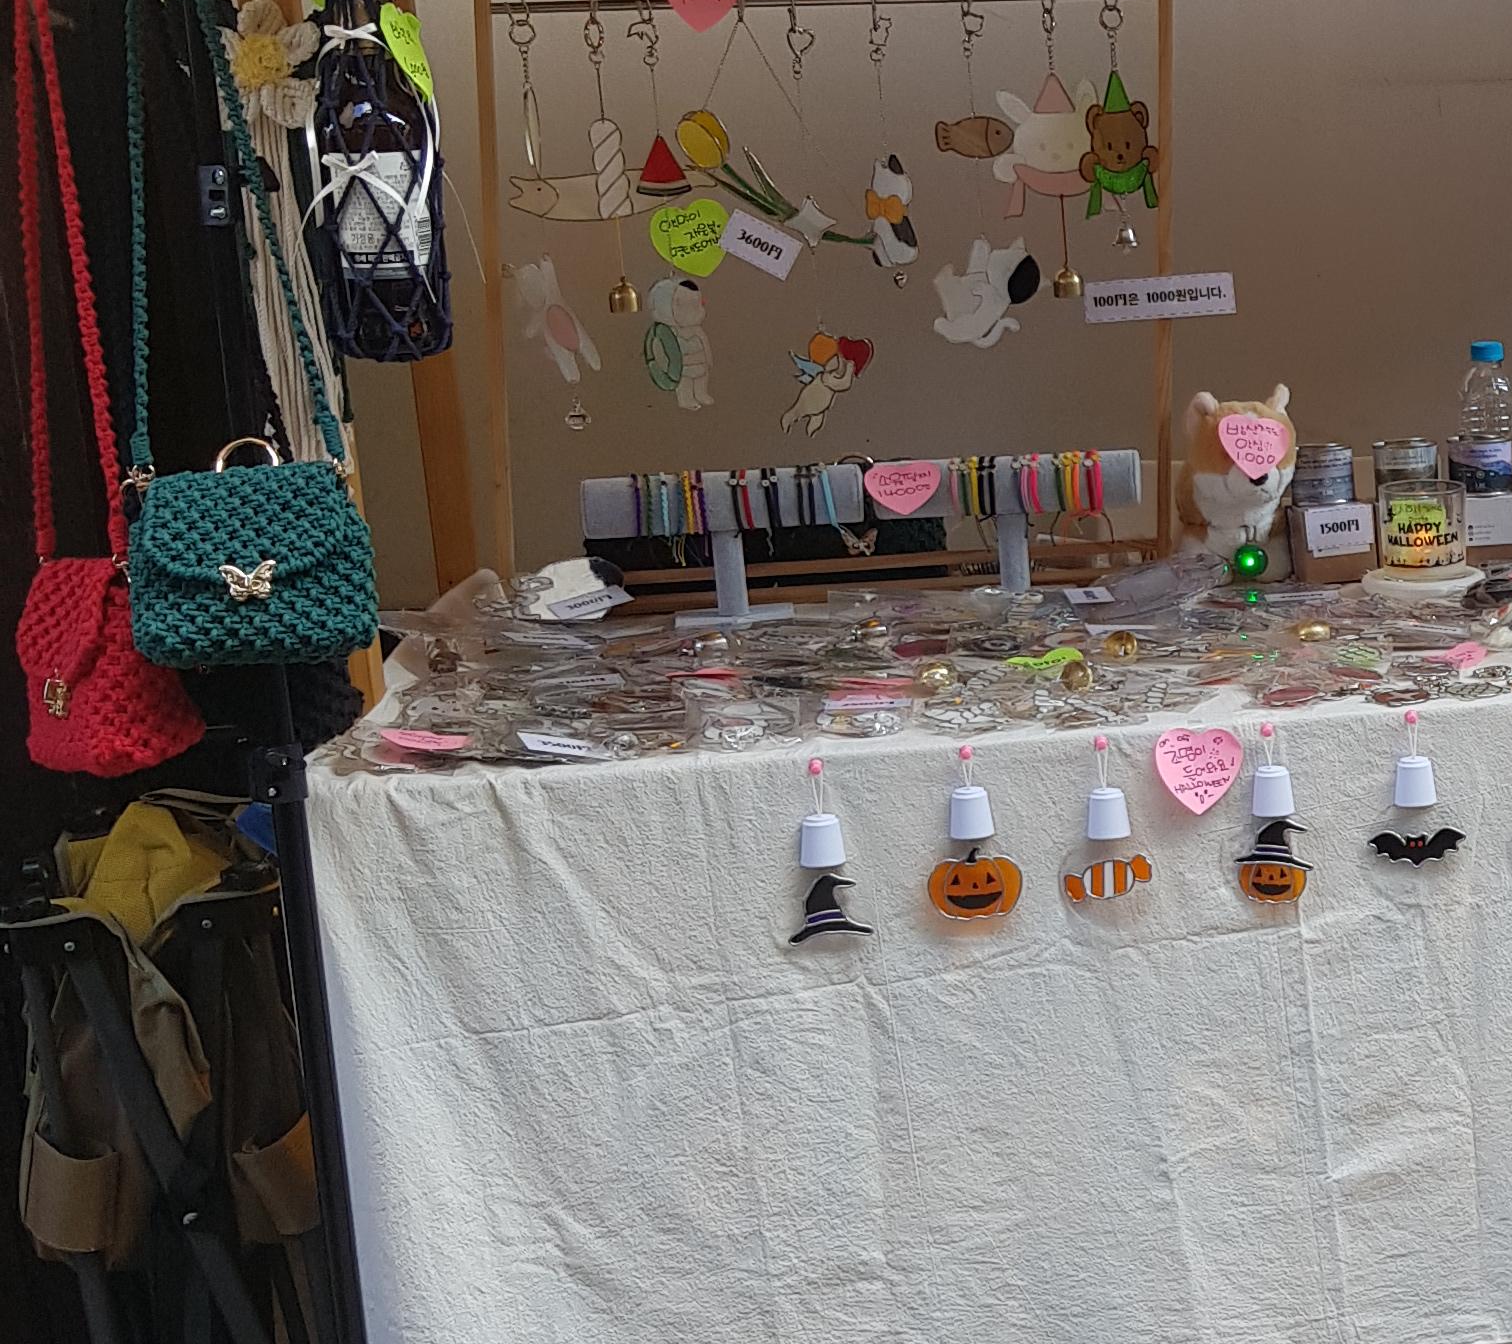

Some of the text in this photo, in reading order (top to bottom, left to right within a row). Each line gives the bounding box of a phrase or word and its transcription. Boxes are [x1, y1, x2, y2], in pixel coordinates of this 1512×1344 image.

[737, 228, 783, 261] 3600円
[1320, 519, 1360, 535] 1500円
[1397, 521, 1442, 535] HAPPY
[1387, 531, 1460, 548] HALLOWEEN
